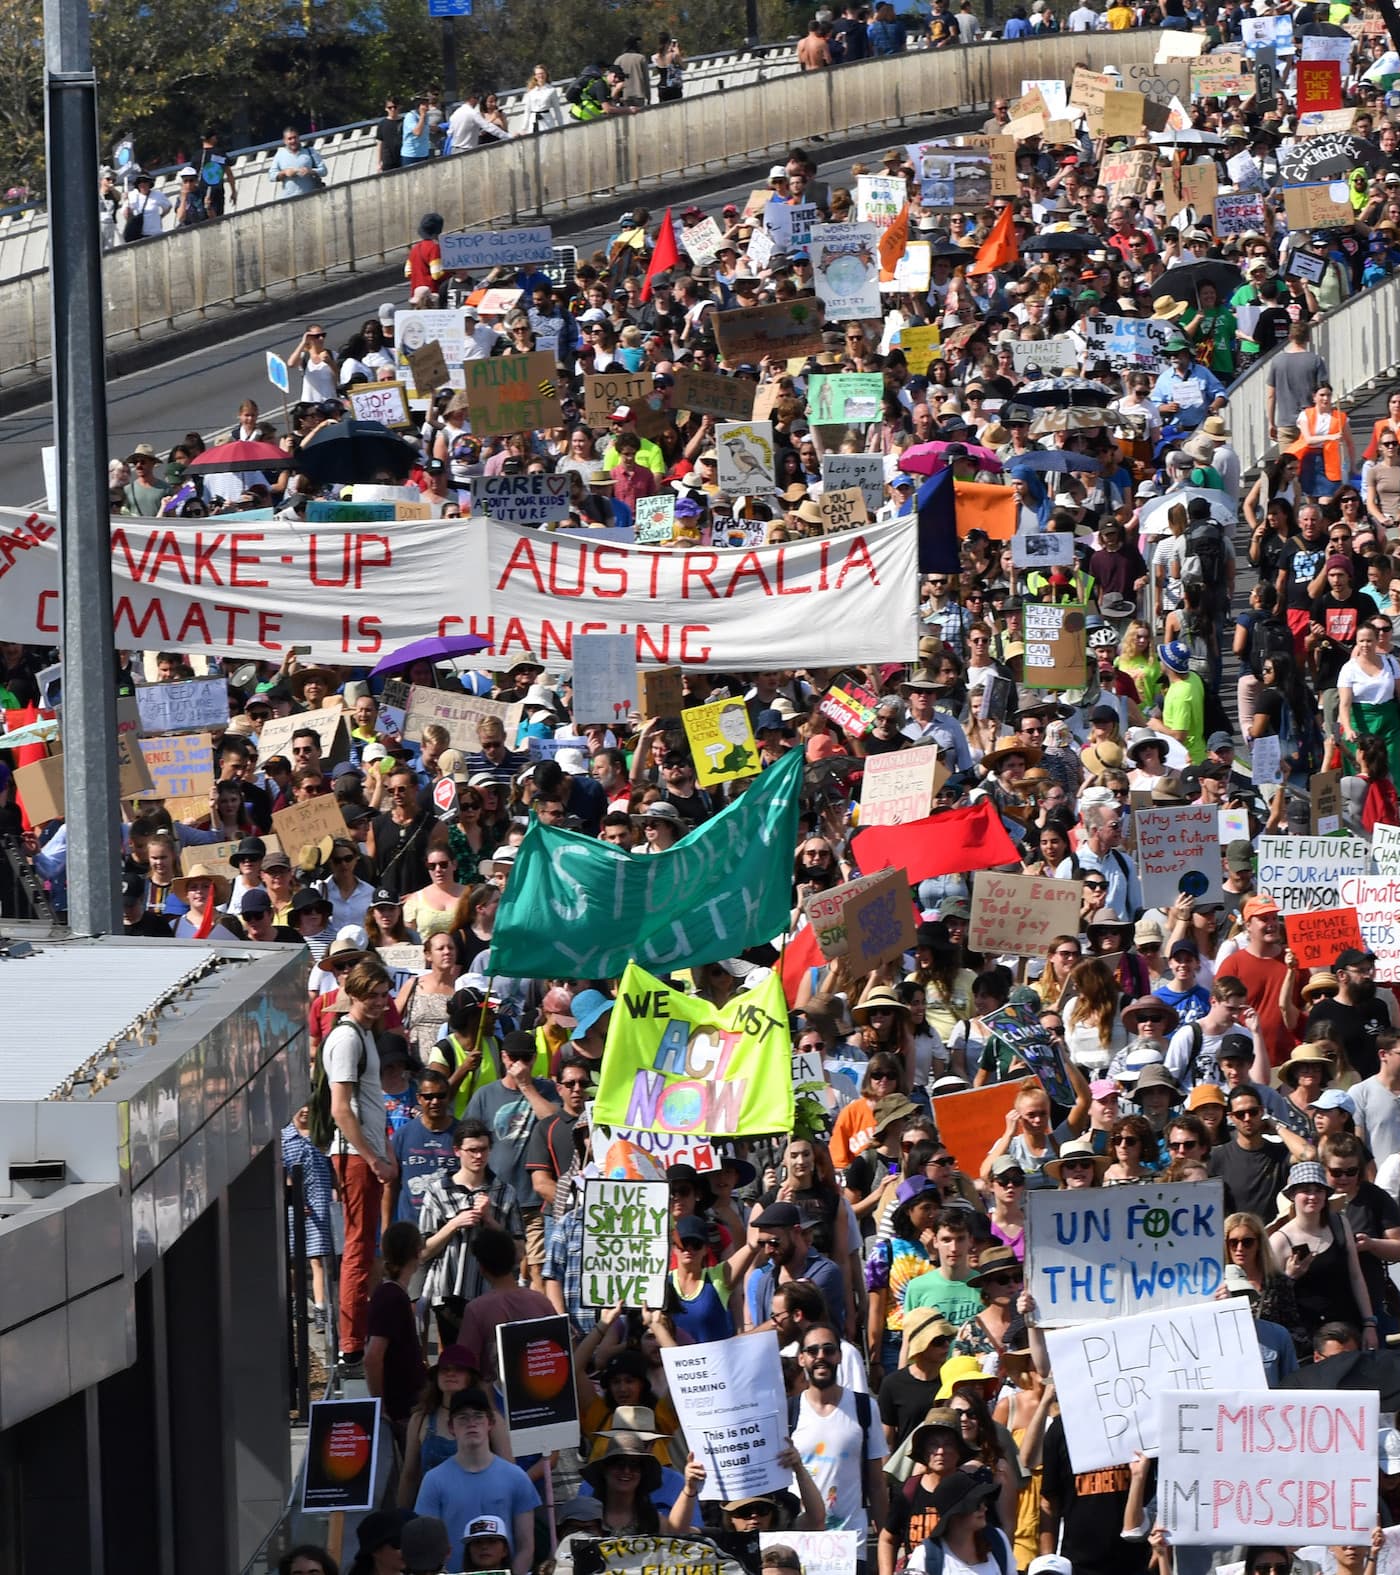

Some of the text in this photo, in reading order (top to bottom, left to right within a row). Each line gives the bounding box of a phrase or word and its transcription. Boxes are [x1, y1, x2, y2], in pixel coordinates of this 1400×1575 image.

[1304, 71, 1332, 80] FUCK
[1304, 80, 1329, 90] THIS
[1293, 142, 1361, 181] EMERGENCY
[444, 231, 549, 249] STOP GLOBAL
[1089, 317, 1114, 335] The
[1015, 341, 1062, 355] CLIMATE
[472, 357, 530, 387] AINT
[594, 379, 647, 399] DO IT
[356, 391, 392, 412] STOP
[473, 475, 543, 496] I CARE
[514, 495, 537, 508] OUR
[823, 501, 855, 515] CAN'T
[829, 493, 848, 504] YOU
[831, 512, 852, 525] EAT
[497, 536, 881, 599] AUSTRALIA
[1028, 606, 1062, 617] PLANT
[1028, 617, 1062, 627] TREES
[342, 615, 383, 653] IS
[1028, 645, 1050, 655] CAN
[1028, 656, 1055, 667] LIVE
[819, 700, 851, 729] doing
[1139, 810, 1213, 831] Why study
[1140, 830, 1219, 848] for a future
[1261, 838, 1364, 860] THE FUTURE
[1145, 858, 1188, 875] have?
[1260, 865, 1319, 884] OF OUR
[987, 880, 1077, 902] You Earn
[810, 895, 844, 919] STOP
[979, 899, 1032, 918] Today
[1017, 918, 1050, 937] pay
[1299, 915, 1348, 932] CLIMATE
[1292, 927, 1359, 943] EMERGENCY
[623, 990, 671, 1019] WE
[653, 1018, 742, 1082] ACT
[625, 1067, 748, 1133] NOW
[600, 1185, 647, 1207] LIVE
[585, 1204, 667, 1236] SIMPLY
[1051, 1206, 1111, 1246] UN
[599, 1238, 653, 1257] SO WE
[585, 1255, 665, 1276] CAN SIMPLY
[1042, 1255, 1224, 1305] THE WORLD
[590, 1276, 650, 1306] LIVE
[1081, 1306, 1250, 1378] PLAN IT
[674, 1356, 708, 1368] WORST
[677, 1370, 709, 1382] HOUSE
[680, 1382, 727, 1395] WARMING
[1094, 1364, 1214, 1412] FOR THE
[703, 1423, 761, 1442] This is not
[1178, 1403, 1366, 1455] E-MISSION
[704, 1437, 767, 1456] business as
[719, 1454, 751, 1469] usual
[1163, 1476, 1372, 1533] IM-POSSIBLE
[599, 1537, 716, 1560] PROTECT
